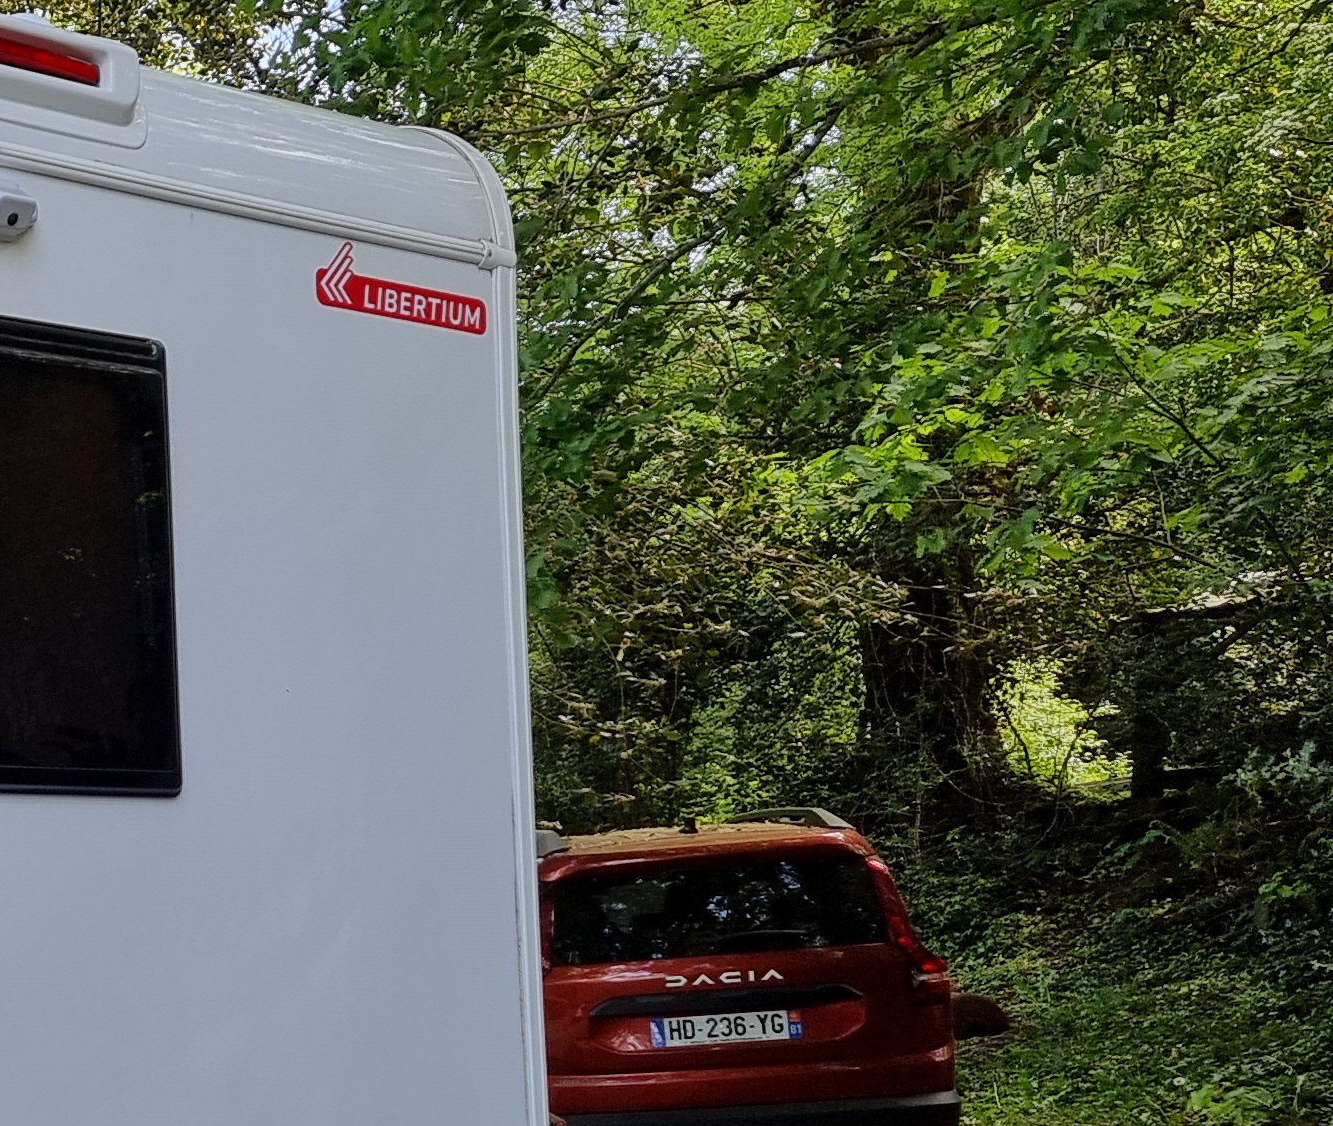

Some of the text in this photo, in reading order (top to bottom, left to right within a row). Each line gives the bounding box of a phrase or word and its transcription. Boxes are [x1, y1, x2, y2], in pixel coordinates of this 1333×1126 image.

[363, 284, 481, 330] LIBERTIUM
[665, 968, 785, 988] DACIA
[668, 1013, 803, 1041] HD-236-YG 81
